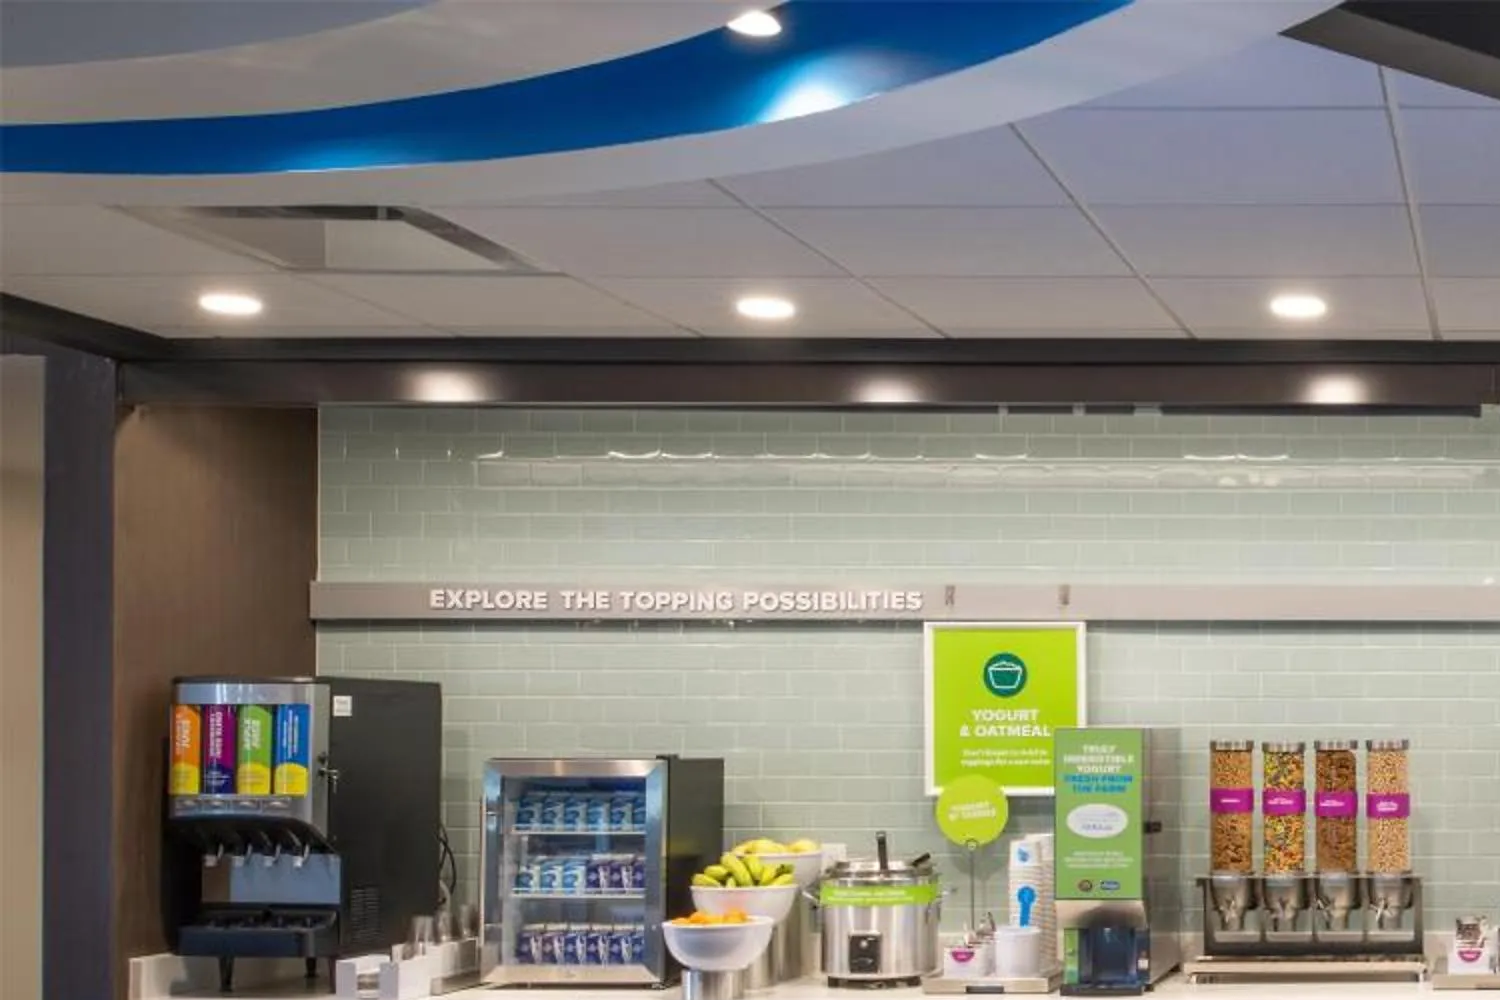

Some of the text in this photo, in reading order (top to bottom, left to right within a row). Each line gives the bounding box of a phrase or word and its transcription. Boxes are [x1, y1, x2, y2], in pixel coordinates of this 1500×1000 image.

[430, 589, 924, 611] EXPLORE THE TOPPING POSSIBILITIES
[971, 709, 1040, 721] YOGURT
[960, 725, 1051, 737] & OATMEAL
